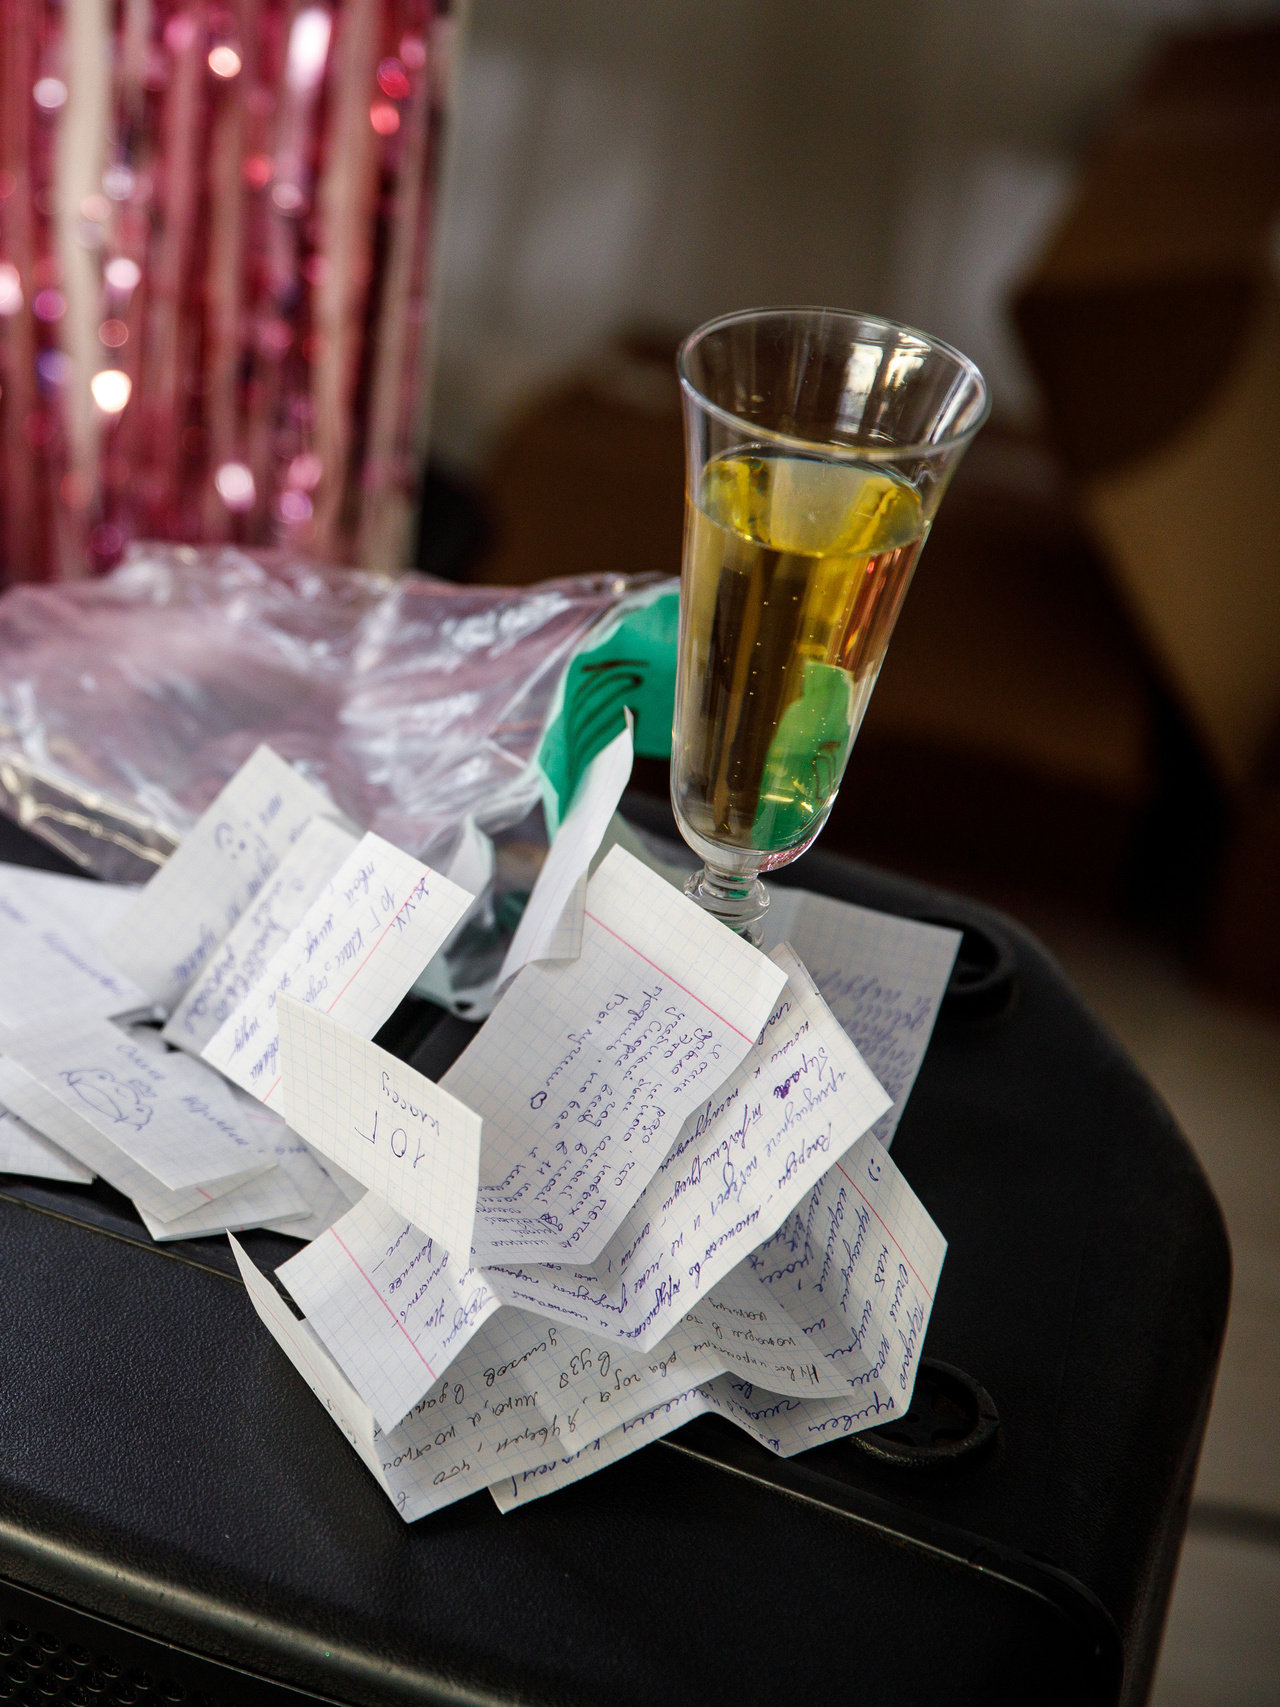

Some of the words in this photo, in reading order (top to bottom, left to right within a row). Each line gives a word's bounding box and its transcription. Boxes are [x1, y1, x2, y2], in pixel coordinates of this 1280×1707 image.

[663, 1033, 694, 1059] Это
[673, 1054, 709, 1094] очень
[381, 1070, 440, 1136] классу
[582, 1094, 616, 1128] год
[353, 1109, 379, 1145] Г
[390, 1127, 426, 1169] 10
[614, 1161, 636, 1187] что
